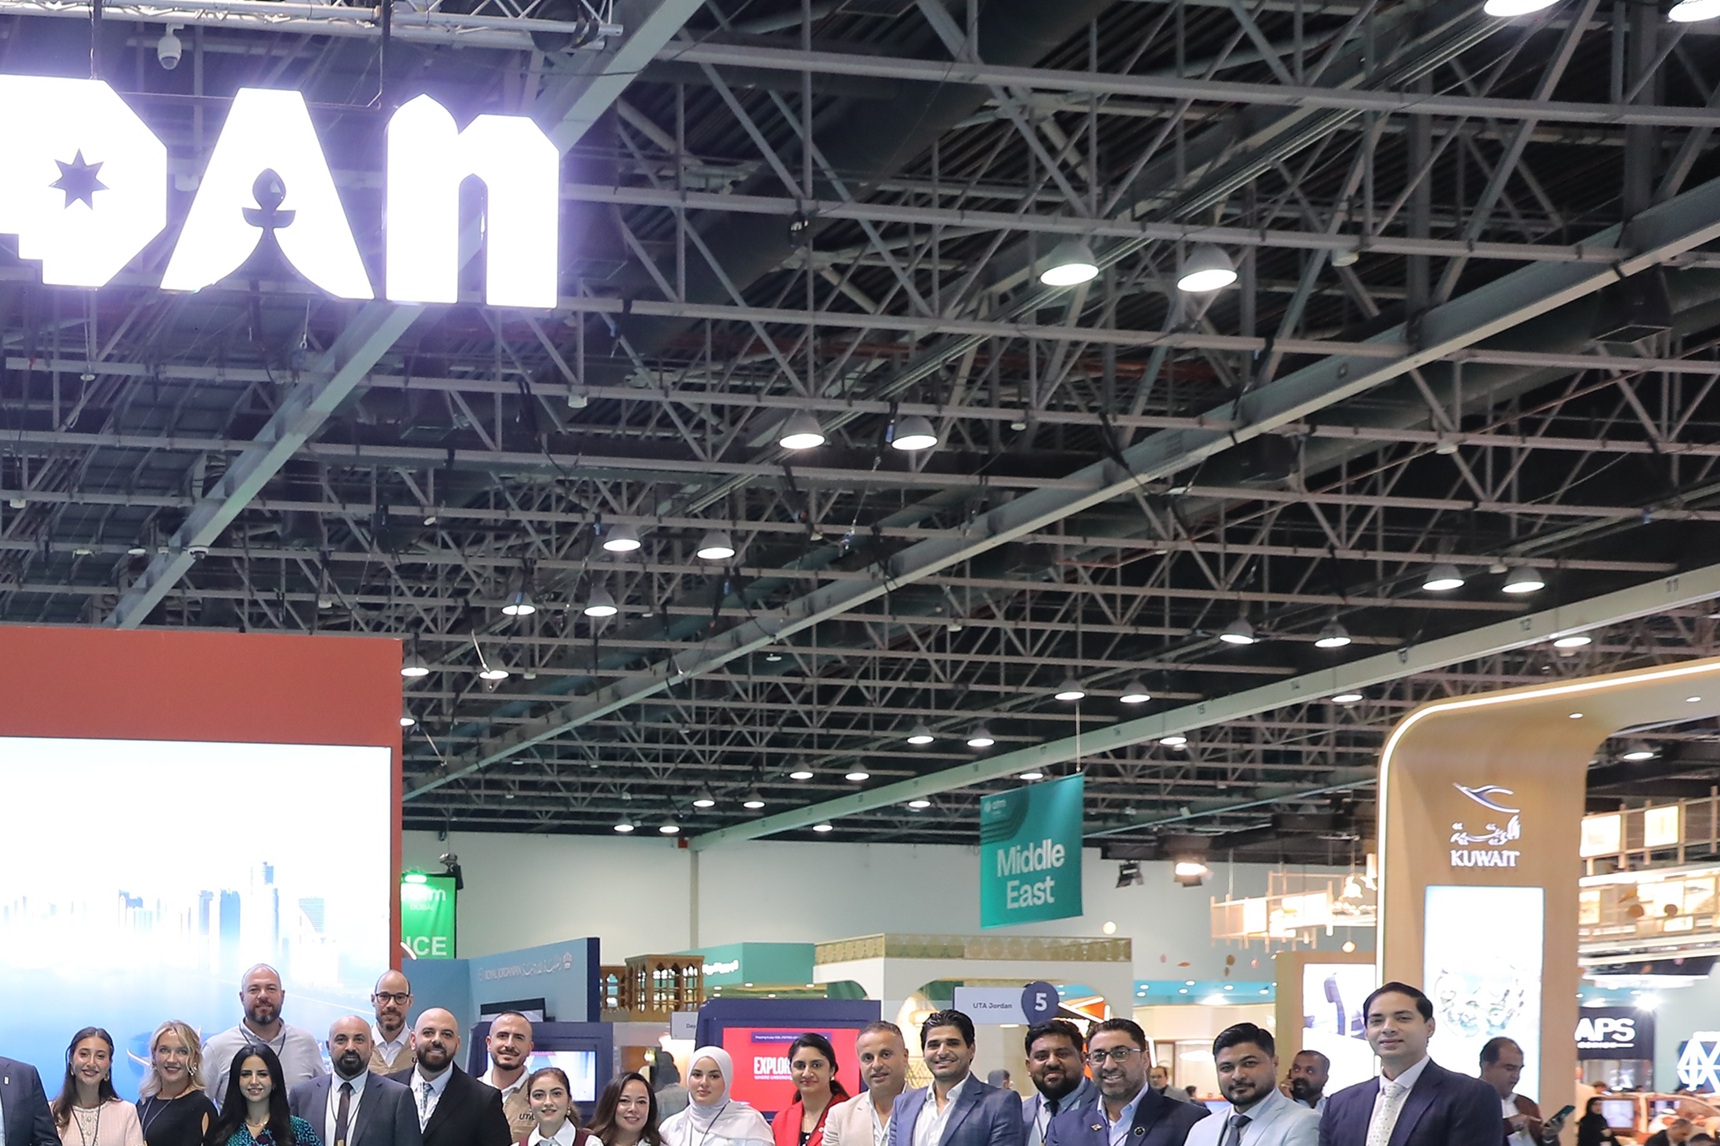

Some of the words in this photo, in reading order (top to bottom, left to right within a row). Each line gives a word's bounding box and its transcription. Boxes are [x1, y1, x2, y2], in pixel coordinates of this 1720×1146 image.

[996, 838, 1066, 878] Middle
[1449, 849, 1521, 867] KUWAIT
[1006, 875, 1056, 910] East
[1034, 992, 1048, 1011] 5
[1574, 1017, 1636, 1041] APS
